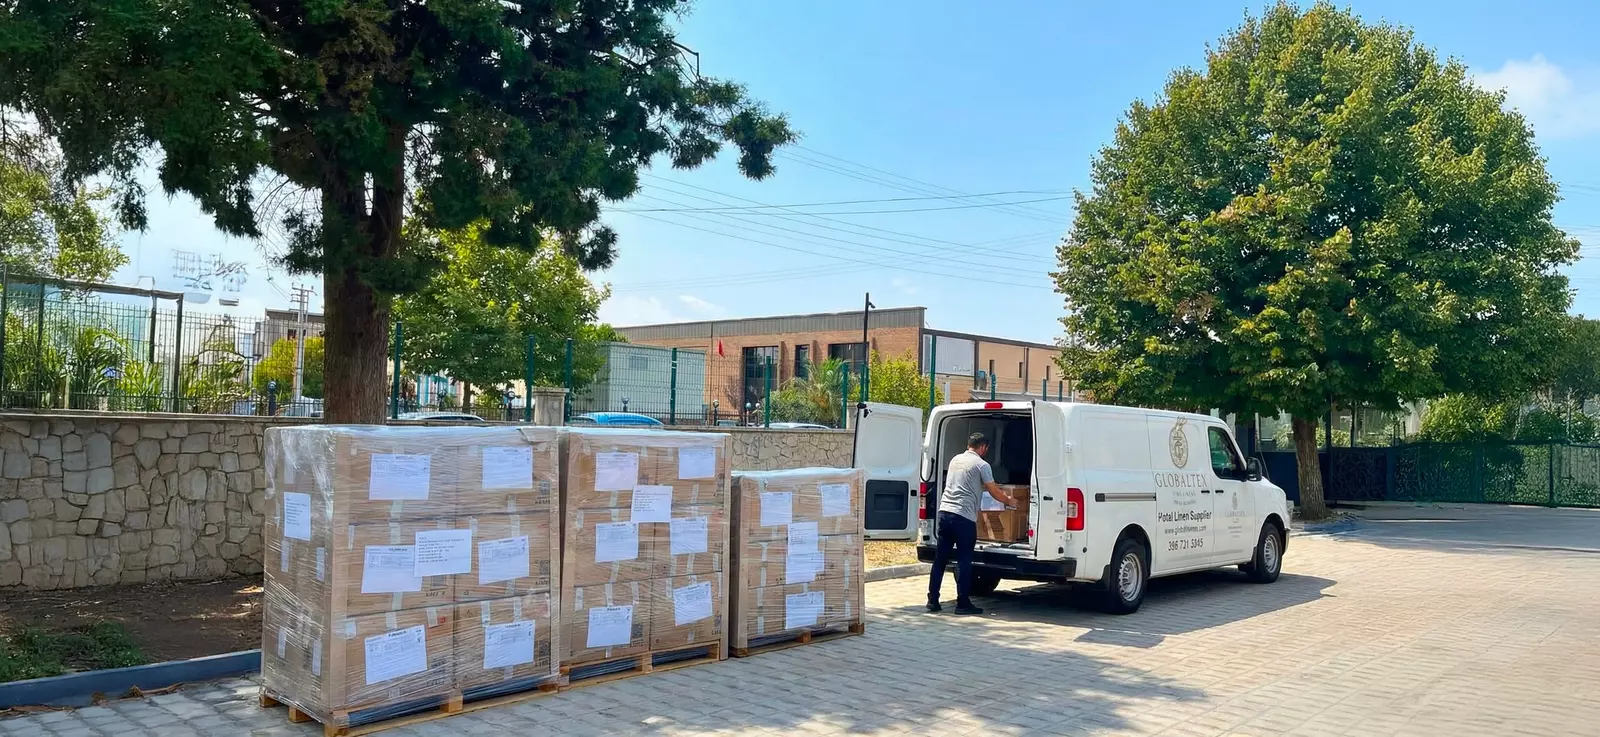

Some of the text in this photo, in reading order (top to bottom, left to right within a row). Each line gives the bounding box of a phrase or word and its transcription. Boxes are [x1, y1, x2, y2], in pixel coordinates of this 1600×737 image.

[1155, 473, 1207, 487] GLOBALTEX
[1174, 511, 1189, 521] Linen
[1190, 510, 1211, 522] Supplier
